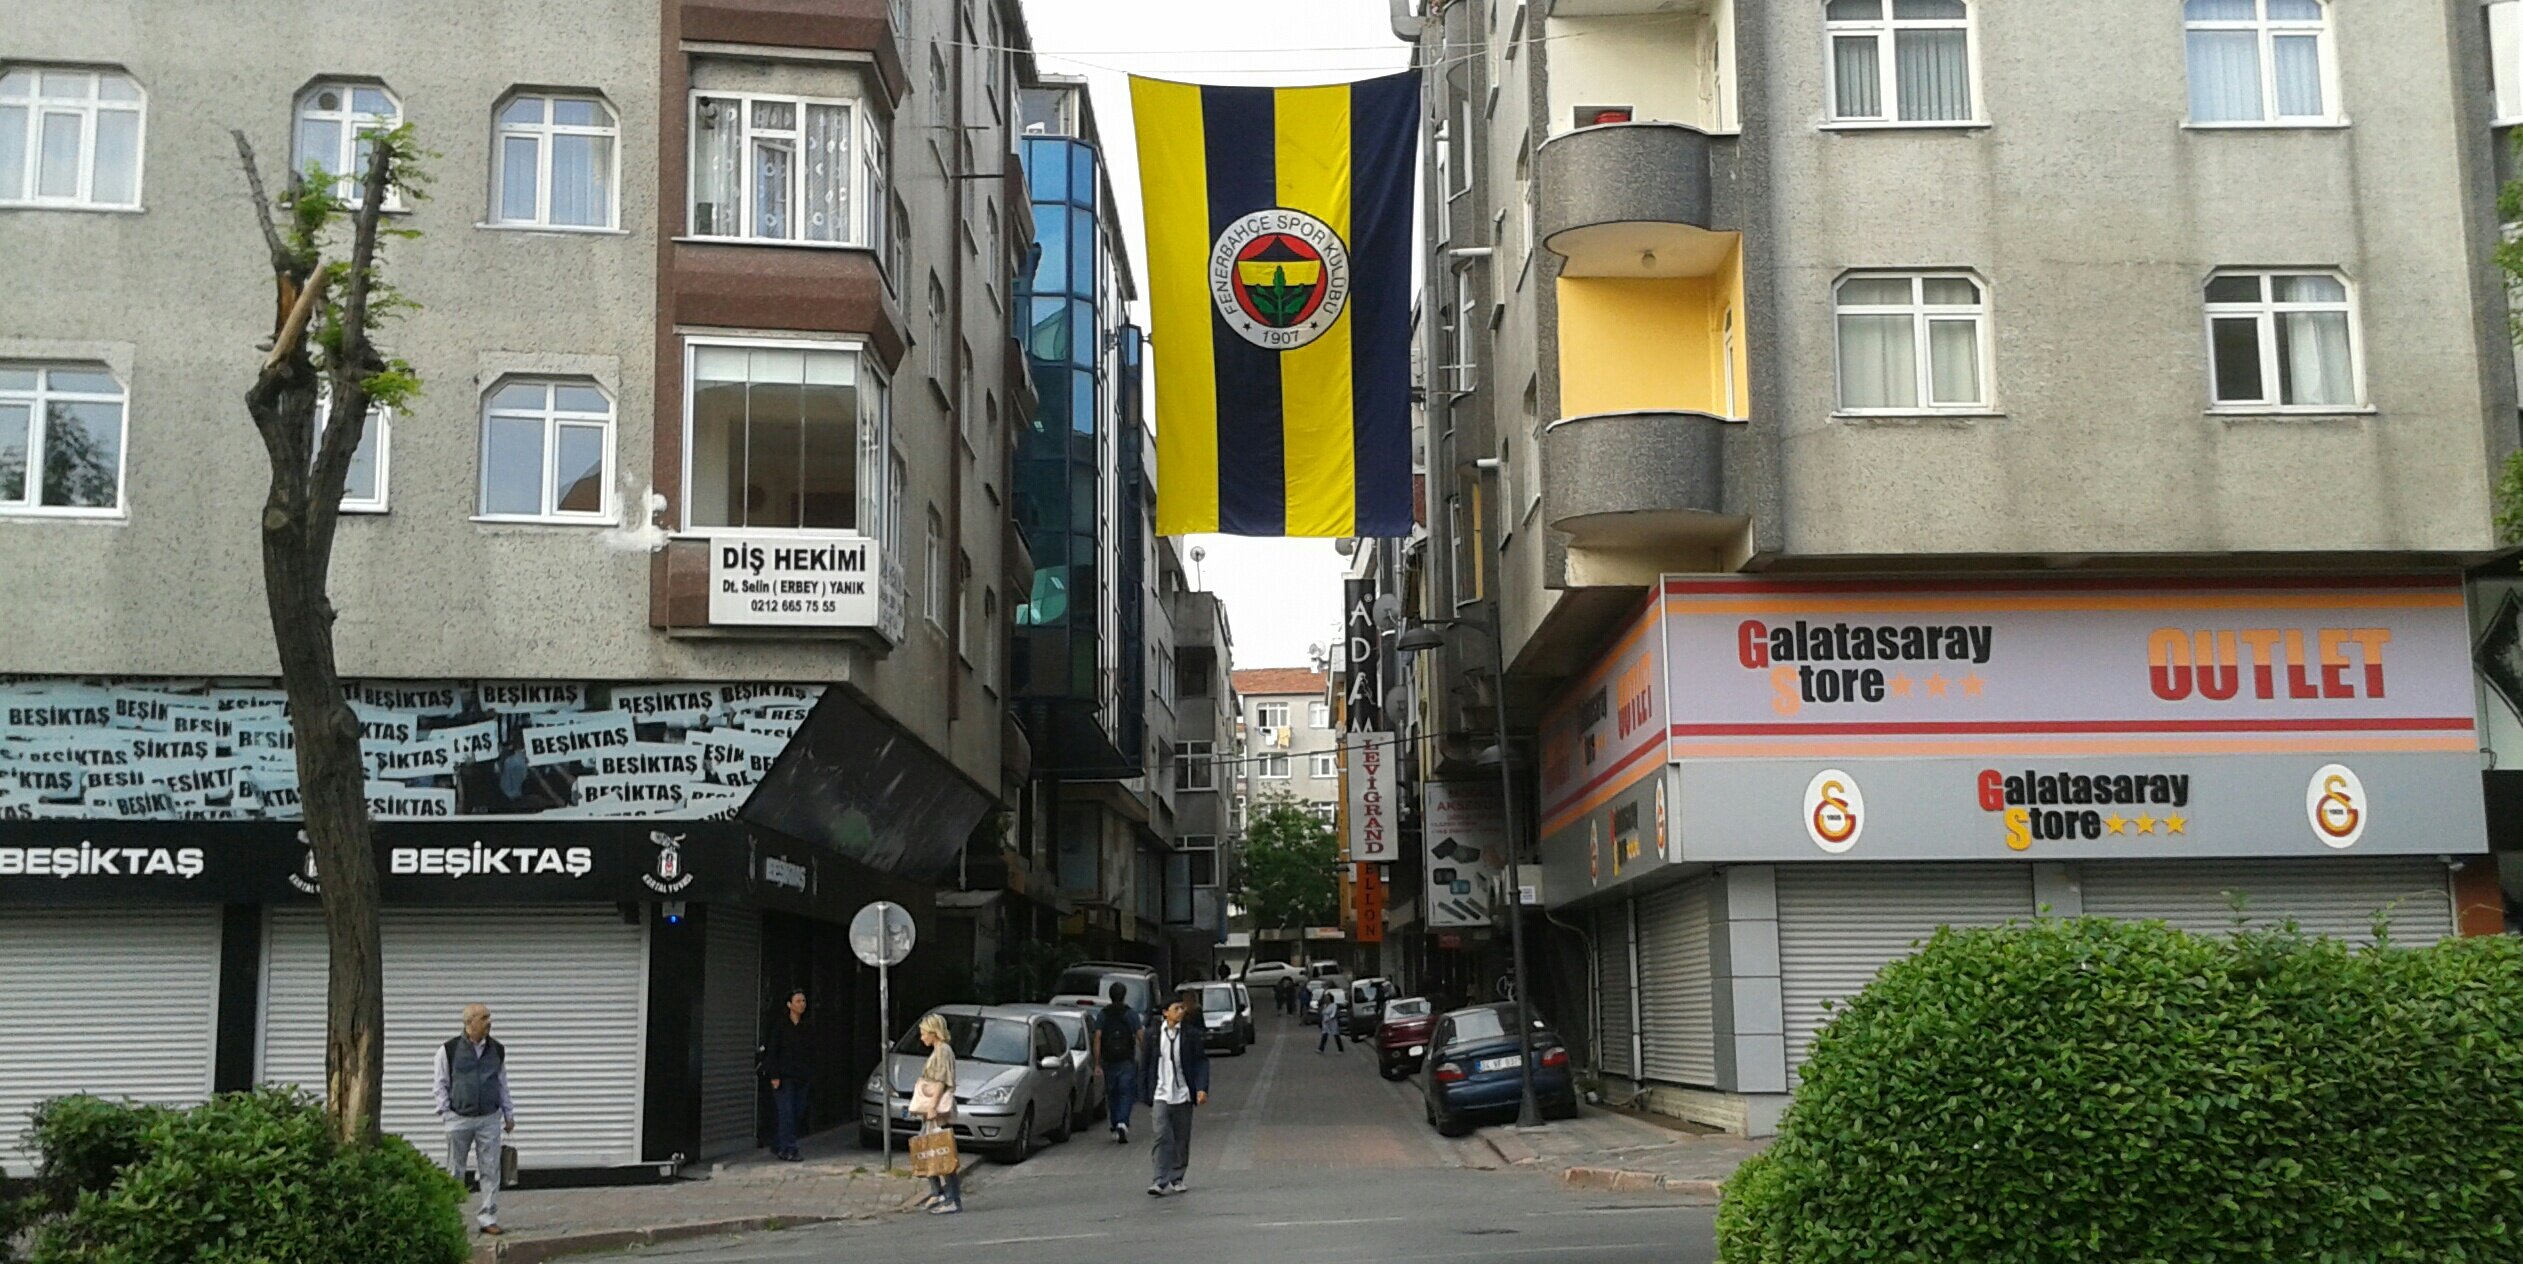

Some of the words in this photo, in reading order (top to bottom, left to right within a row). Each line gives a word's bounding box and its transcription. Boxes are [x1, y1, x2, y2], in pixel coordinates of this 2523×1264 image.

[1215, 216, 1271, 315] FENERBAHÇE
[1276, 215, 1326, 245] SPOR
[1262, 330, 1299, 344] 1907
[722, 542, 765, 576] DİŞ
[774, 544, 866, 572] HEKİMİ
[722, 579, 738, 593] Dt.
[742, 580, 769, 594] Selin
[780, 580, 819, 594] ERBEY
[830, 581, 865, 595] YANIK
[751, 600, 778, 612] 0212
[781, 600, 802, 612] 665
[806, 600, 819, 612] 75
[823, 600, 836, 612] 55
[1737, 619, 1992, 669] Galatasaray
[2147, 627, 2391, 701] OUTLET
[364, 686, 455, 711] BEŞİKTAŞ
[484, 683, 578, 706] BEŞİKTAŞ
[618, 691, 713, 716] BEŞİKTAŞ
[1769, 666, 1885, 717] Store
[9, 705, 110, 727] BEŞİKTAŞ
[531, 727, 629, 755] BEŞİKTAŞ
[602, 753, 698, 775] BEŞİKTAŞ
[1362, 738, 1384, 854] LEVİGRAND
[1977, 769, 2189, 811] Galatasaray
[2004, 808, 2101, 851] Store
[0, 841, 204, 879] BEŞİKTAŞ
[391, 841, 592, 879] BEŞİKTAŞ
